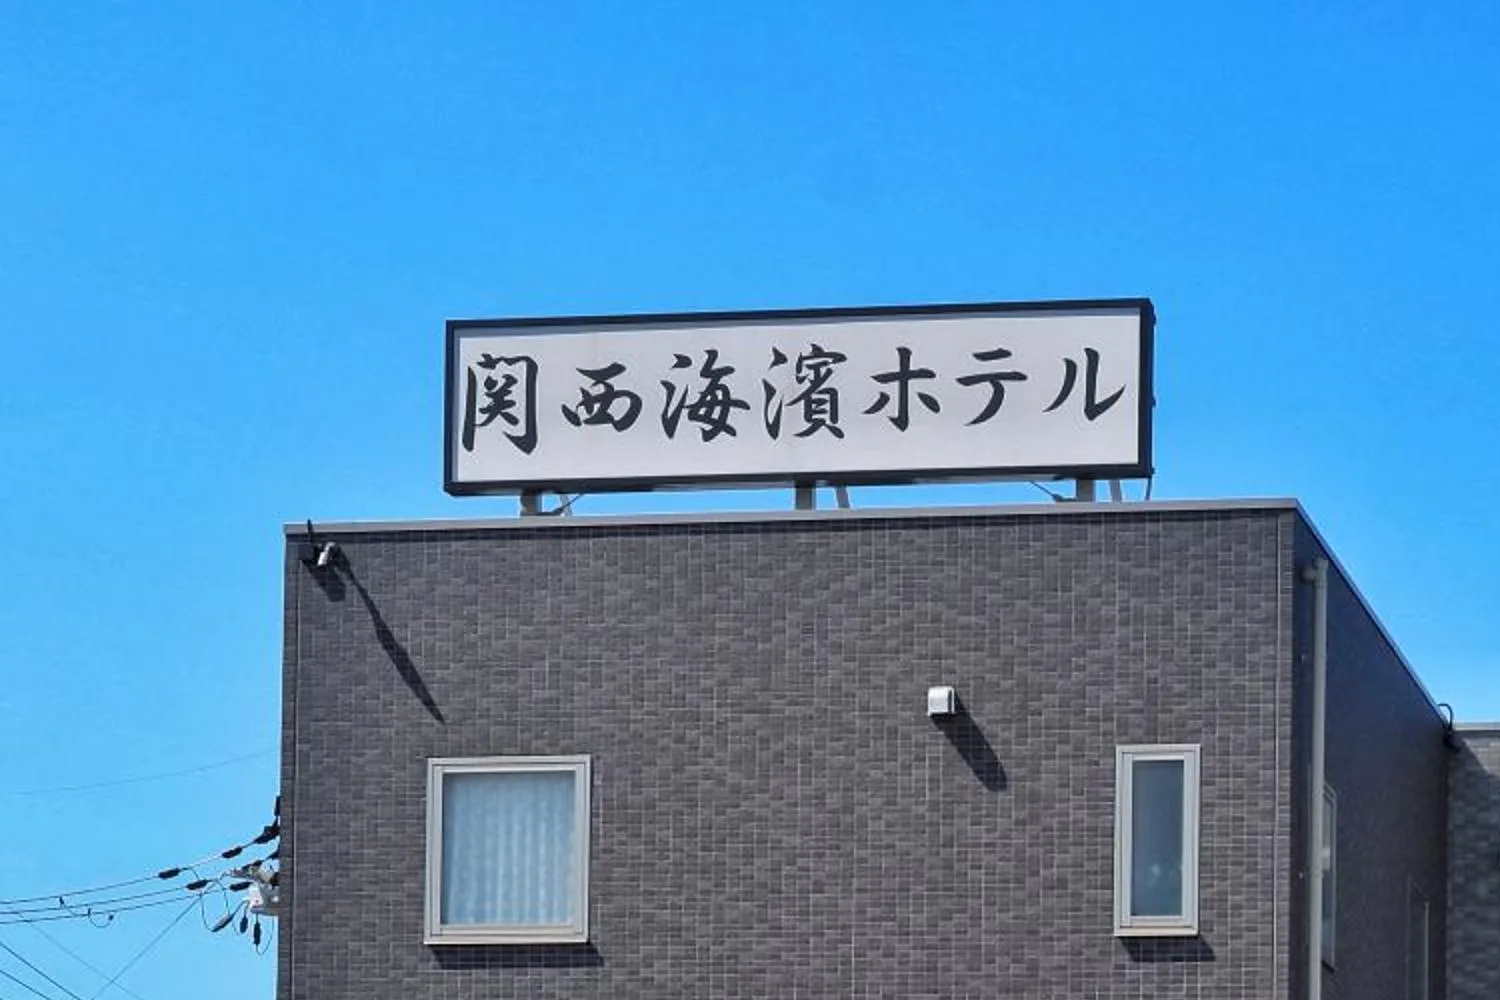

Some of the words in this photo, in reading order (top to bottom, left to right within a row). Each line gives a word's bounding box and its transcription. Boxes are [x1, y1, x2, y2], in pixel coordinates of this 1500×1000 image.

[460, 344, 1126, 454] 関西海濱ホテル
